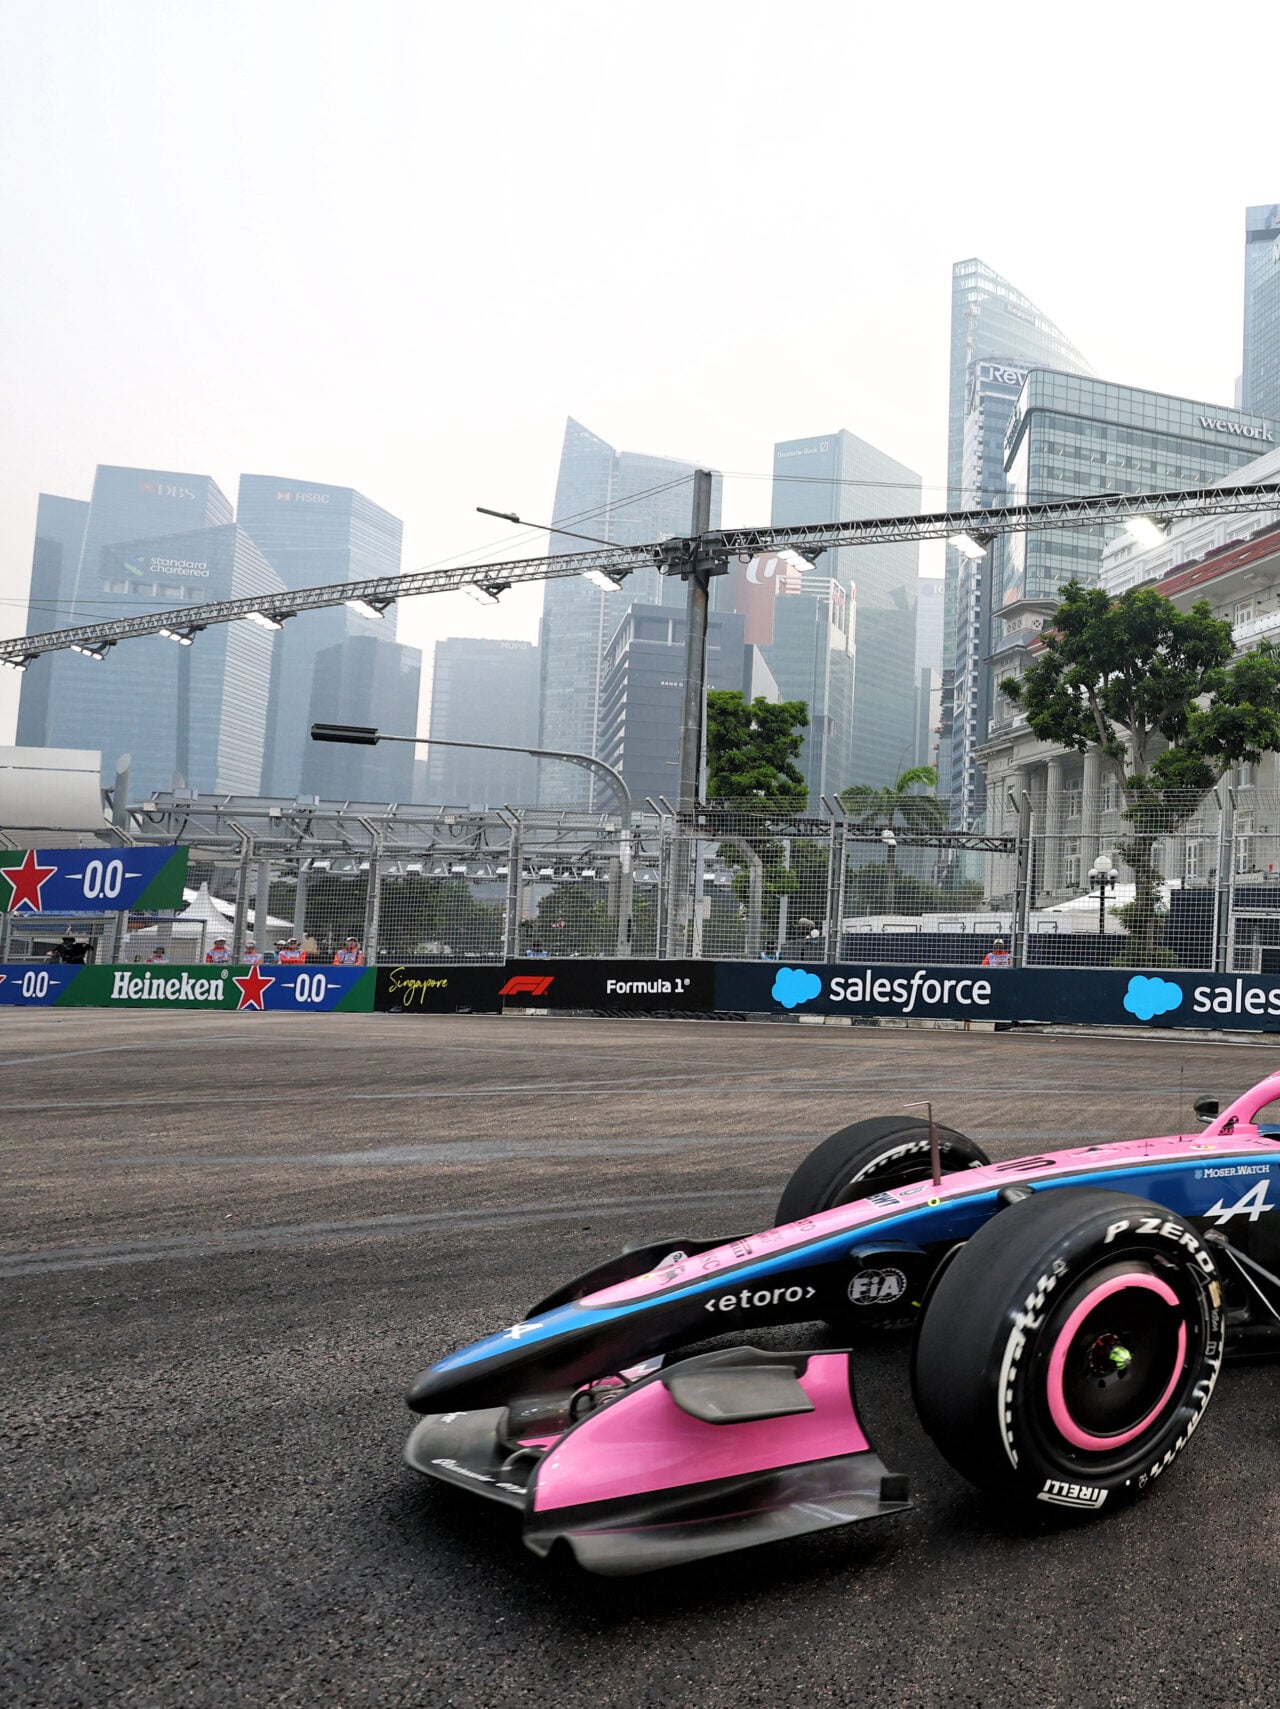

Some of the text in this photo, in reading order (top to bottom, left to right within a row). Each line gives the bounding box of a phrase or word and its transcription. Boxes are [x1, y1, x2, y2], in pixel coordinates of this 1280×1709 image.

[1200, 416, 1275, 442] wework
[157, 484, 195, 500] DBS
[295, 492, 330, 504] HSBC
[150, 556, 207, 570] standard
[150, 564, 210, 578] chartered
[82, 859, 122, 899] 0.0
[22, 971, 49, 998] 0.0
[295, 973, 326, 1003] 0.0
[388, 966, 449, 1007] Singapore
[606, 978, 672, 994] Formula
[829, 969, 992, 1013] salesforce
[1104, 1218, 1216, 1274] P ZERO
[1037, 1479, 1109, 1509] PIRELLI
